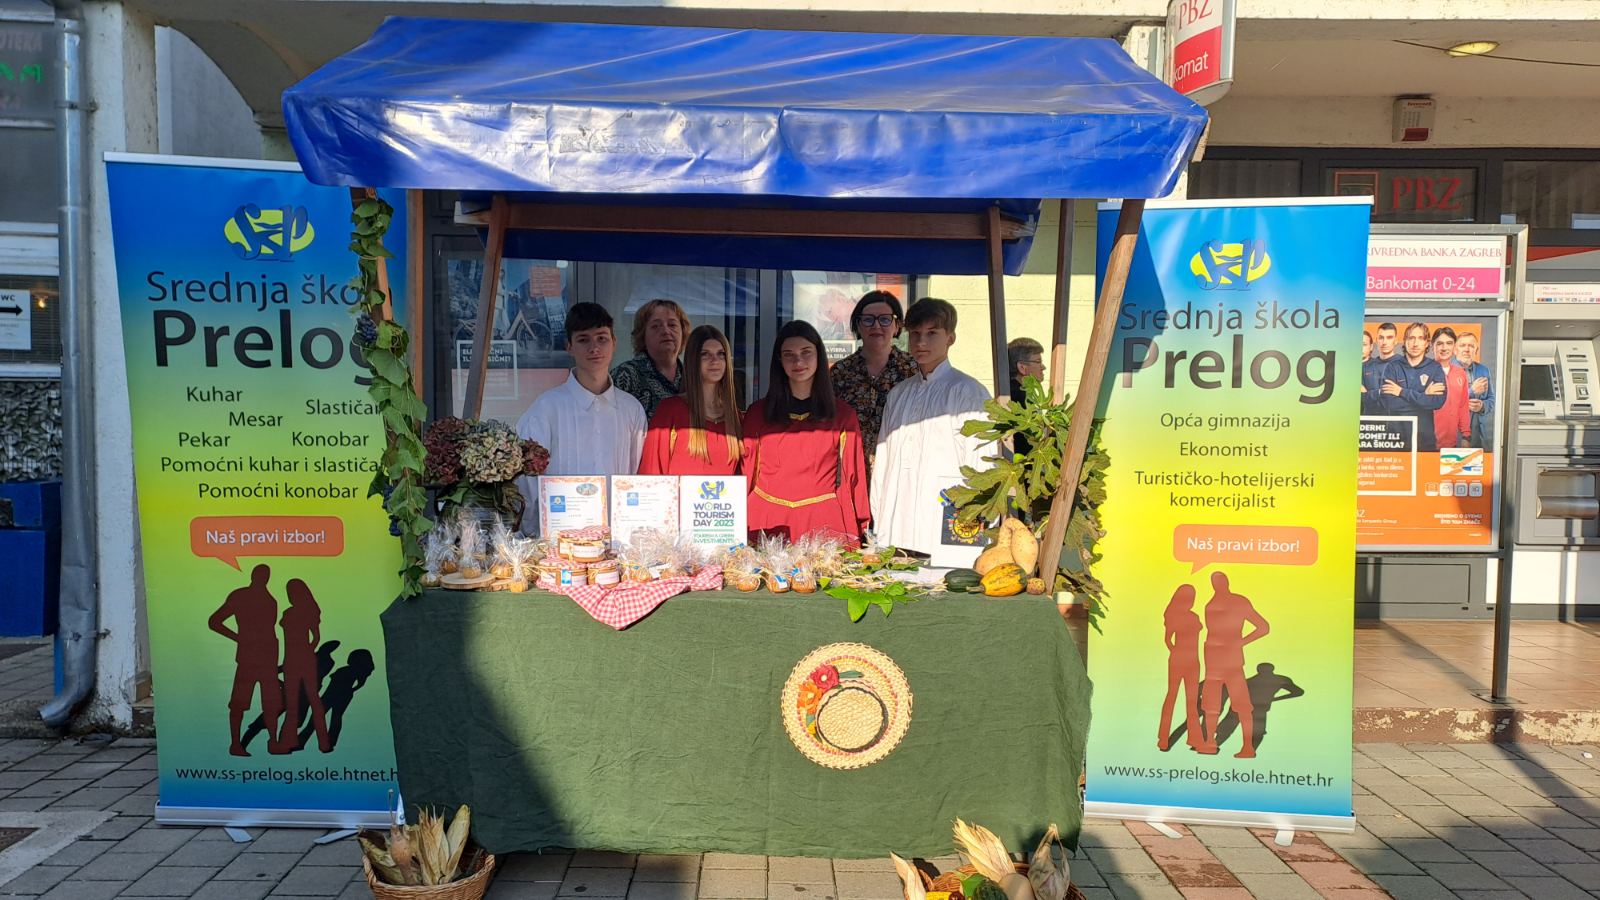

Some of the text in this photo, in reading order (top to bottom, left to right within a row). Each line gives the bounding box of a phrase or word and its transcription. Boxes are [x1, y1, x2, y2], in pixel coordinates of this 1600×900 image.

[1179, 0, 1213, 30] PBZ
[1392, 176, 1462, 210] PBZ
[1420, 248, 1456, 257] BANKA
[1459, 248, 1502, 257] ZAGREB
[1367, 275, 1475, 290] Bankomat 0-24
[147, 271, 288, 311] Srednja
[1121, 300, 1340, 337] Srednja škola
[1122, 334, 1336, 405] Prelog
[186, 386, 243, 402] Kuhar
[229, 411, 283, 427] Mesar
[1160, 412, 1290, 431] Opća gimnazija
[178, 432, 231, 448] Pekar
[292, 432, 370, 447] Konobar
[1373, 440, 1404, 449] ŠKOLA?
[1180, 442, 1268, 457] Ekonomist
[161, 457, 380, 473] Pomoćni kuhar i slastiča
[1134, 471, 1315, 490] Turističko-hotelijerski
[198, 483, 359, 499] Pomoćni konobar
[694, 502, 731, 510] WORLD
[1170, 493, 1276, 510] komercijalist
[206, 529, 325, 546] Naš pravi izbor!
[1187, 536, 1300, 553] Naš pravi izbor!
[1104, 765, 1333, 788] www.ss-prelog.skole.htnet.hr
